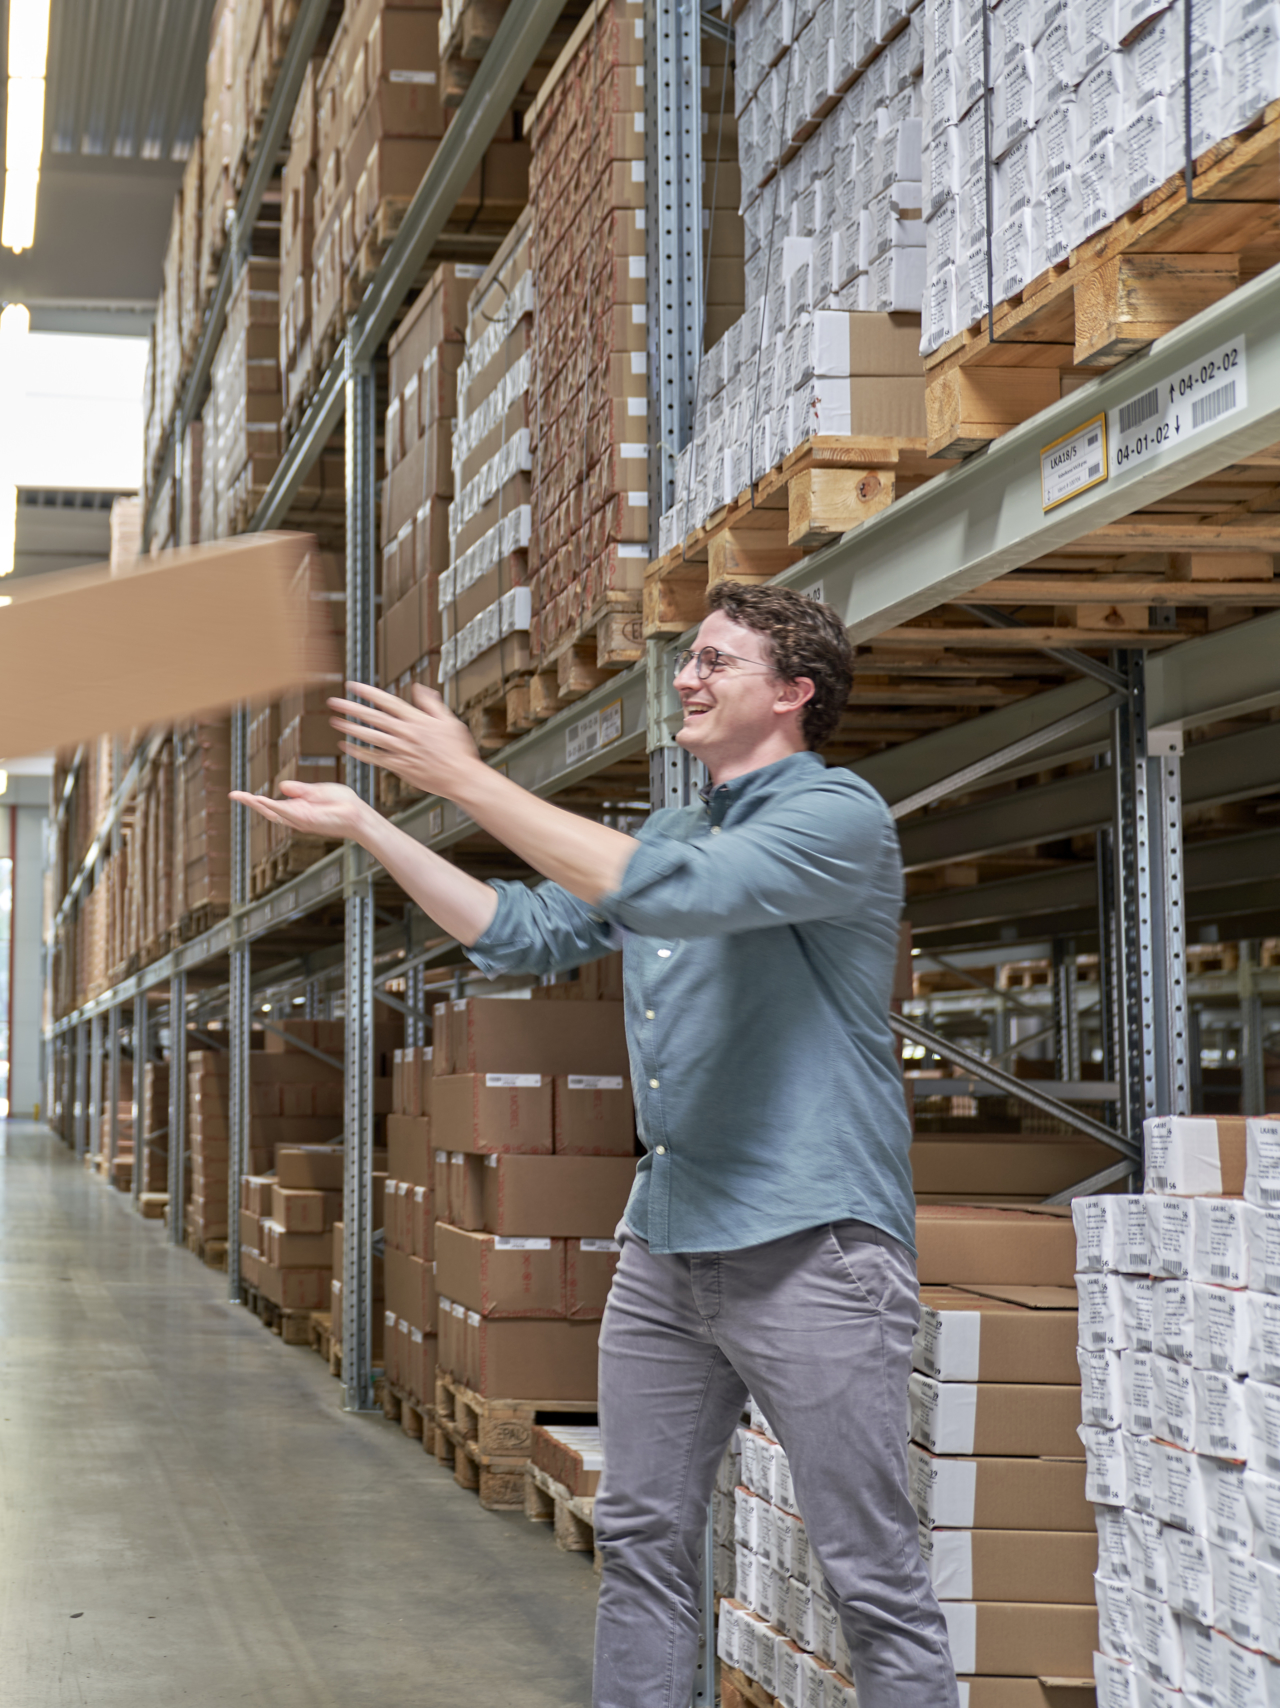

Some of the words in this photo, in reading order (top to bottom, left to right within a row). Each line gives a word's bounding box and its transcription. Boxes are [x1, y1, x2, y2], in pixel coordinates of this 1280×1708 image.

[1179, 348, 1238, 396] 04-02-02
[1050, 445, 1077, 470] LKA18/5
[1117, 423, 1170, 465] 04-01-02
